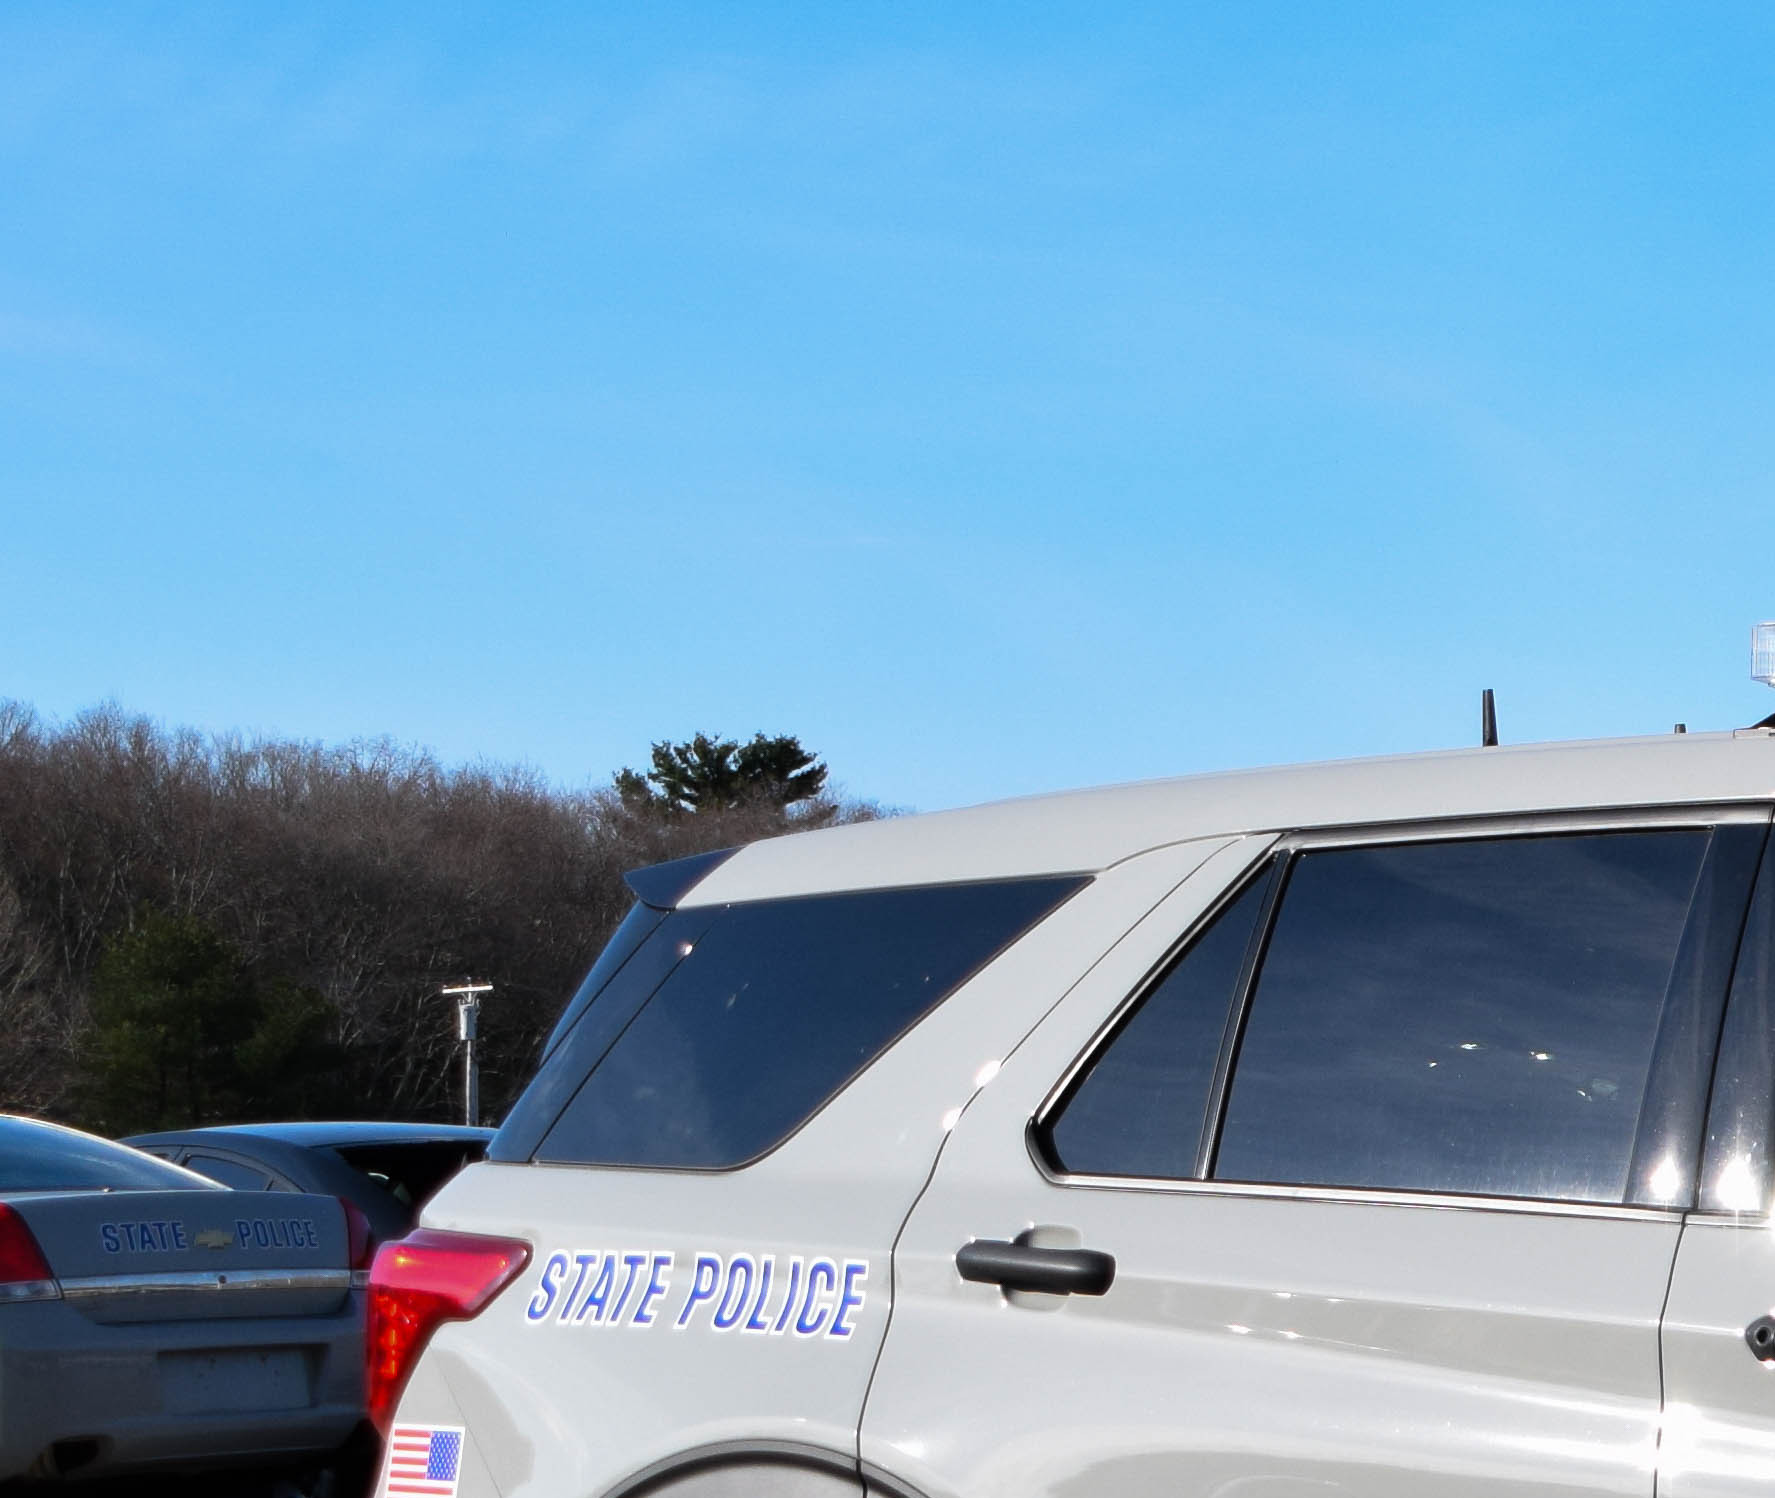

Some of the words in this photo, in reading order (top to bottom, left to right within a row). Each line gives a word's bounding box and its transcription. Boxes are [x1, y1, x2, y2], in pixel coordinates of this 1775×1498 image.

[101, 1221, 189, 1253] STATE
[233, 1218, 319, 1249] POLICE
[524, 1247, 675, 1328] STATE
[674, 1252, 870, 1341] POLICE
